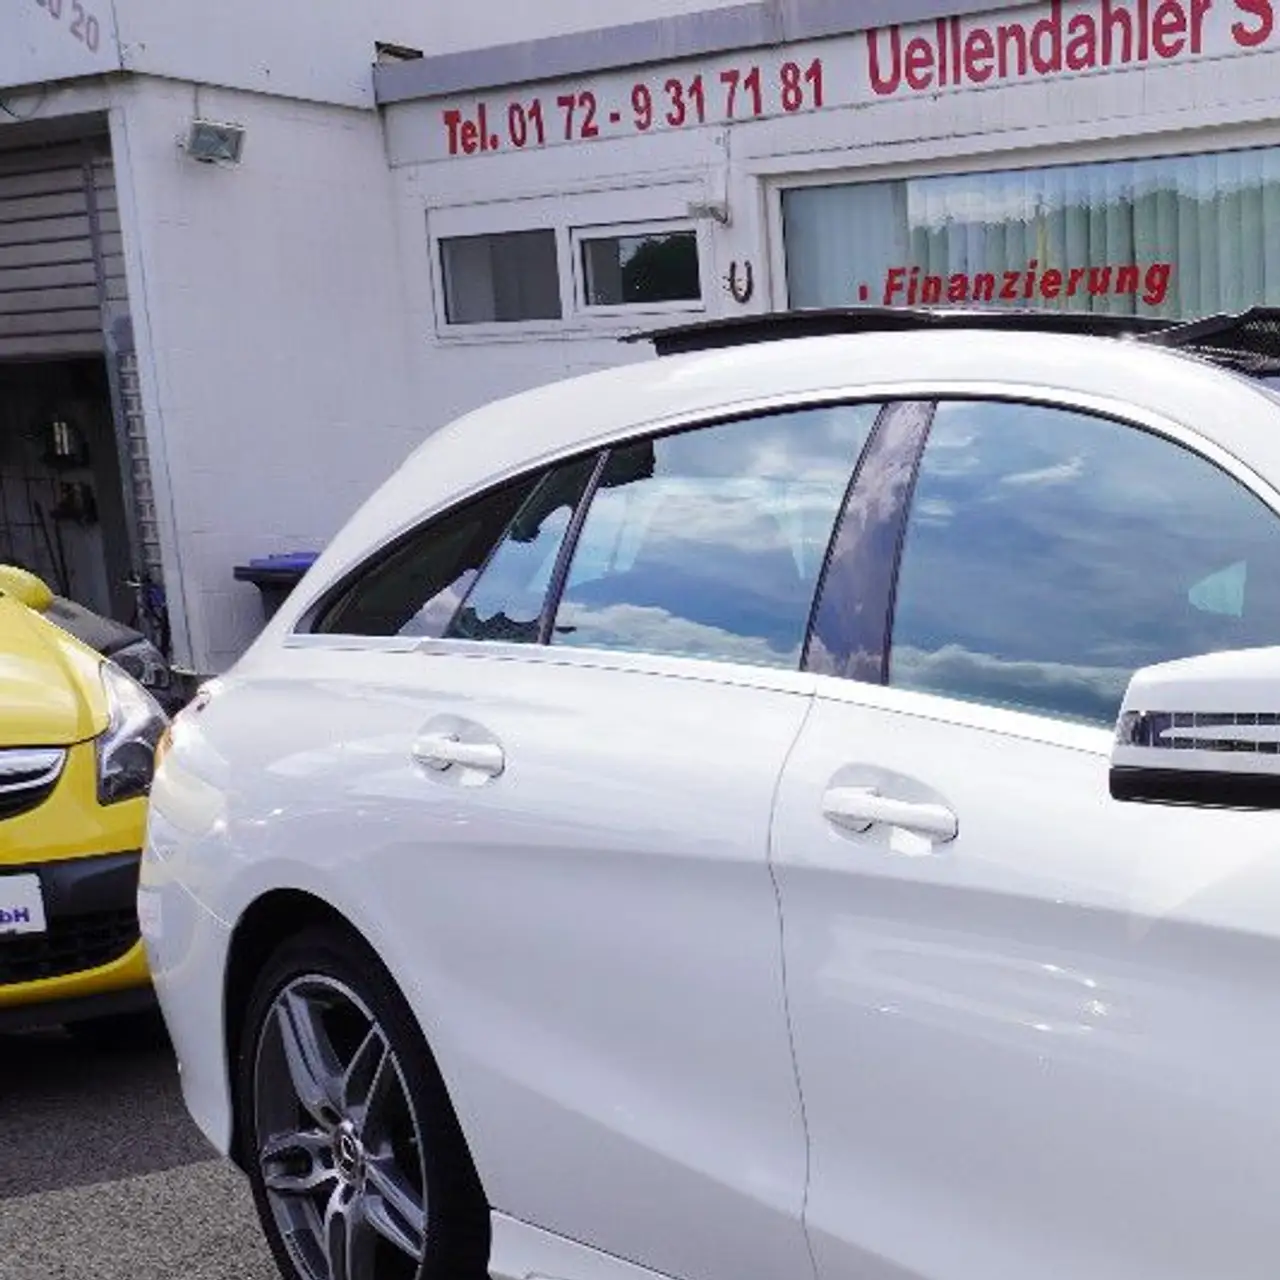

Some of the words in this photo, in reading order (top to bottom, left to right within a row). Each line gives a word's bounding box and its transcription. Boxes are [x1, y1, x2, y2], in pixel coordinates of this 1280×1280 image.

[443, 102, 499, 155] Tel.
[508, 99, 544, 147] 01
[557, 91, 599, 140] 72
[665, 74, 705, 126] 31
[720, 66, 762, 118] 71
[780, 58, 823, 112] 81
[865, 0, 1212, 95] Uellendahler
[883, 259, 1171, 306] Finanzierung
